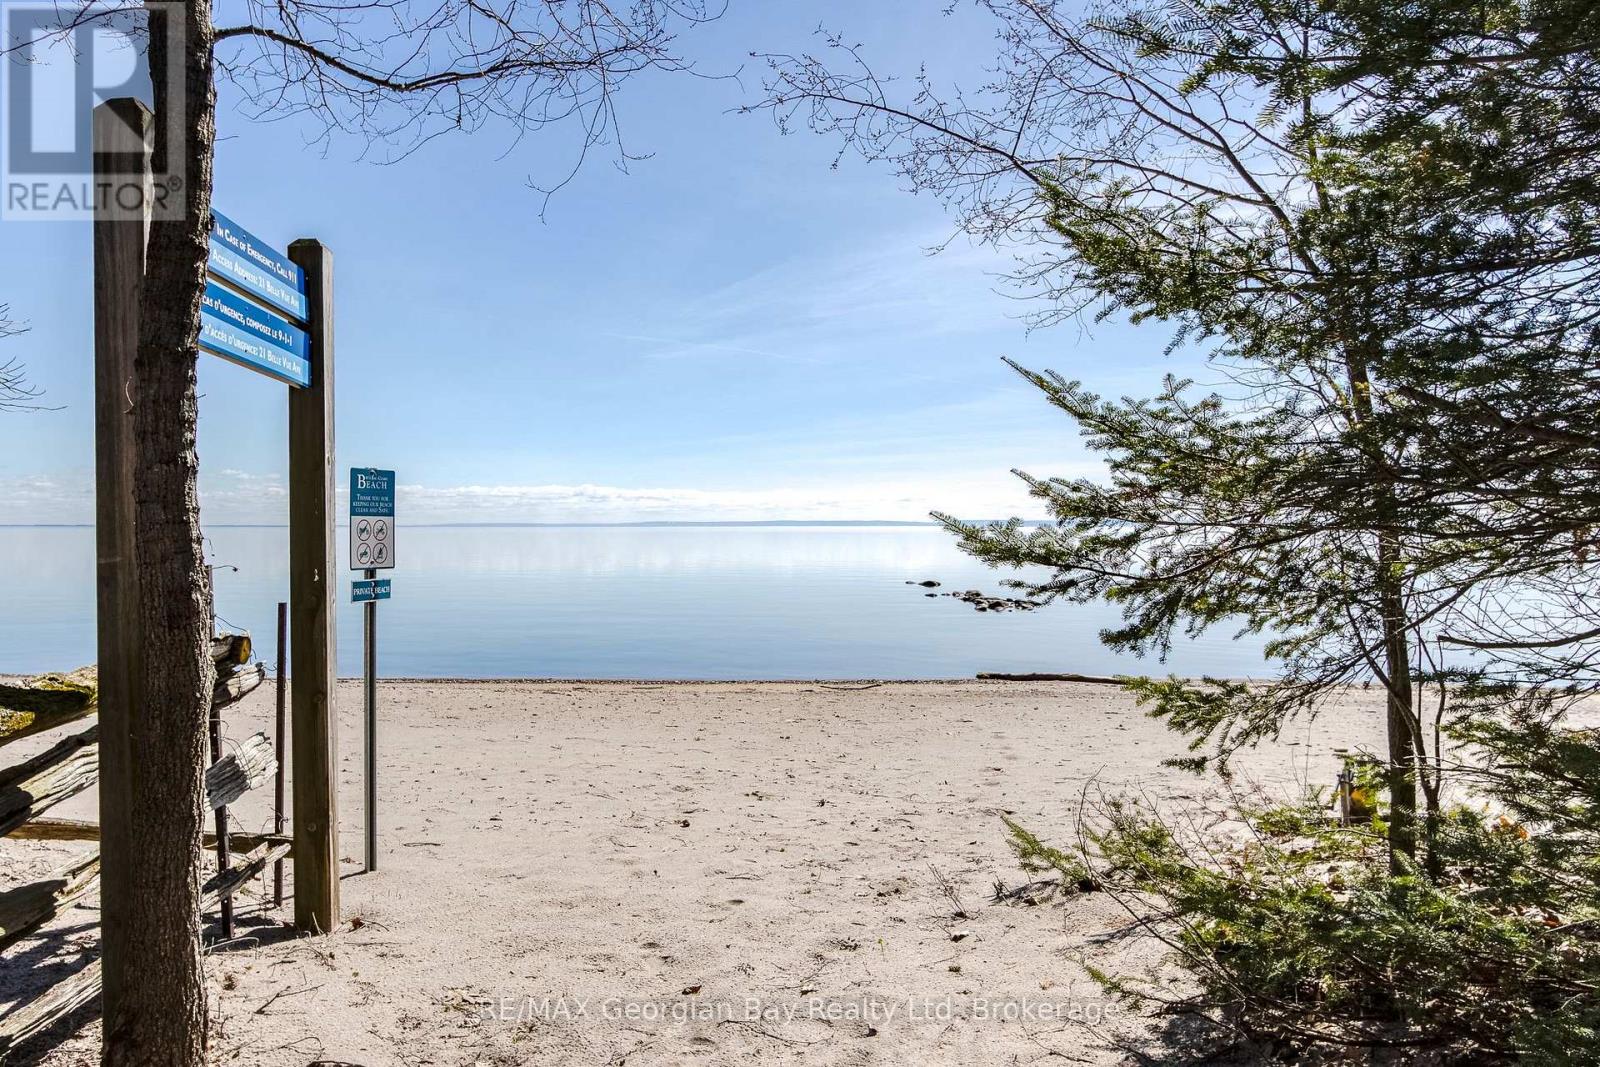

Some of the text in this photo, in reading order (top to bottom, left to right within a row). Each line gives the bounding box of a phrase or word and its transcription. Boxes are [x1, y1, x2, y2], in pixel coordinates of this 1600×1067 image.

[259, 276, 265, 289] 21
[288, 270, 297, 284] 911
[259, 346, 266, 359] 21
[357, 474, 387, 490] BEACH
